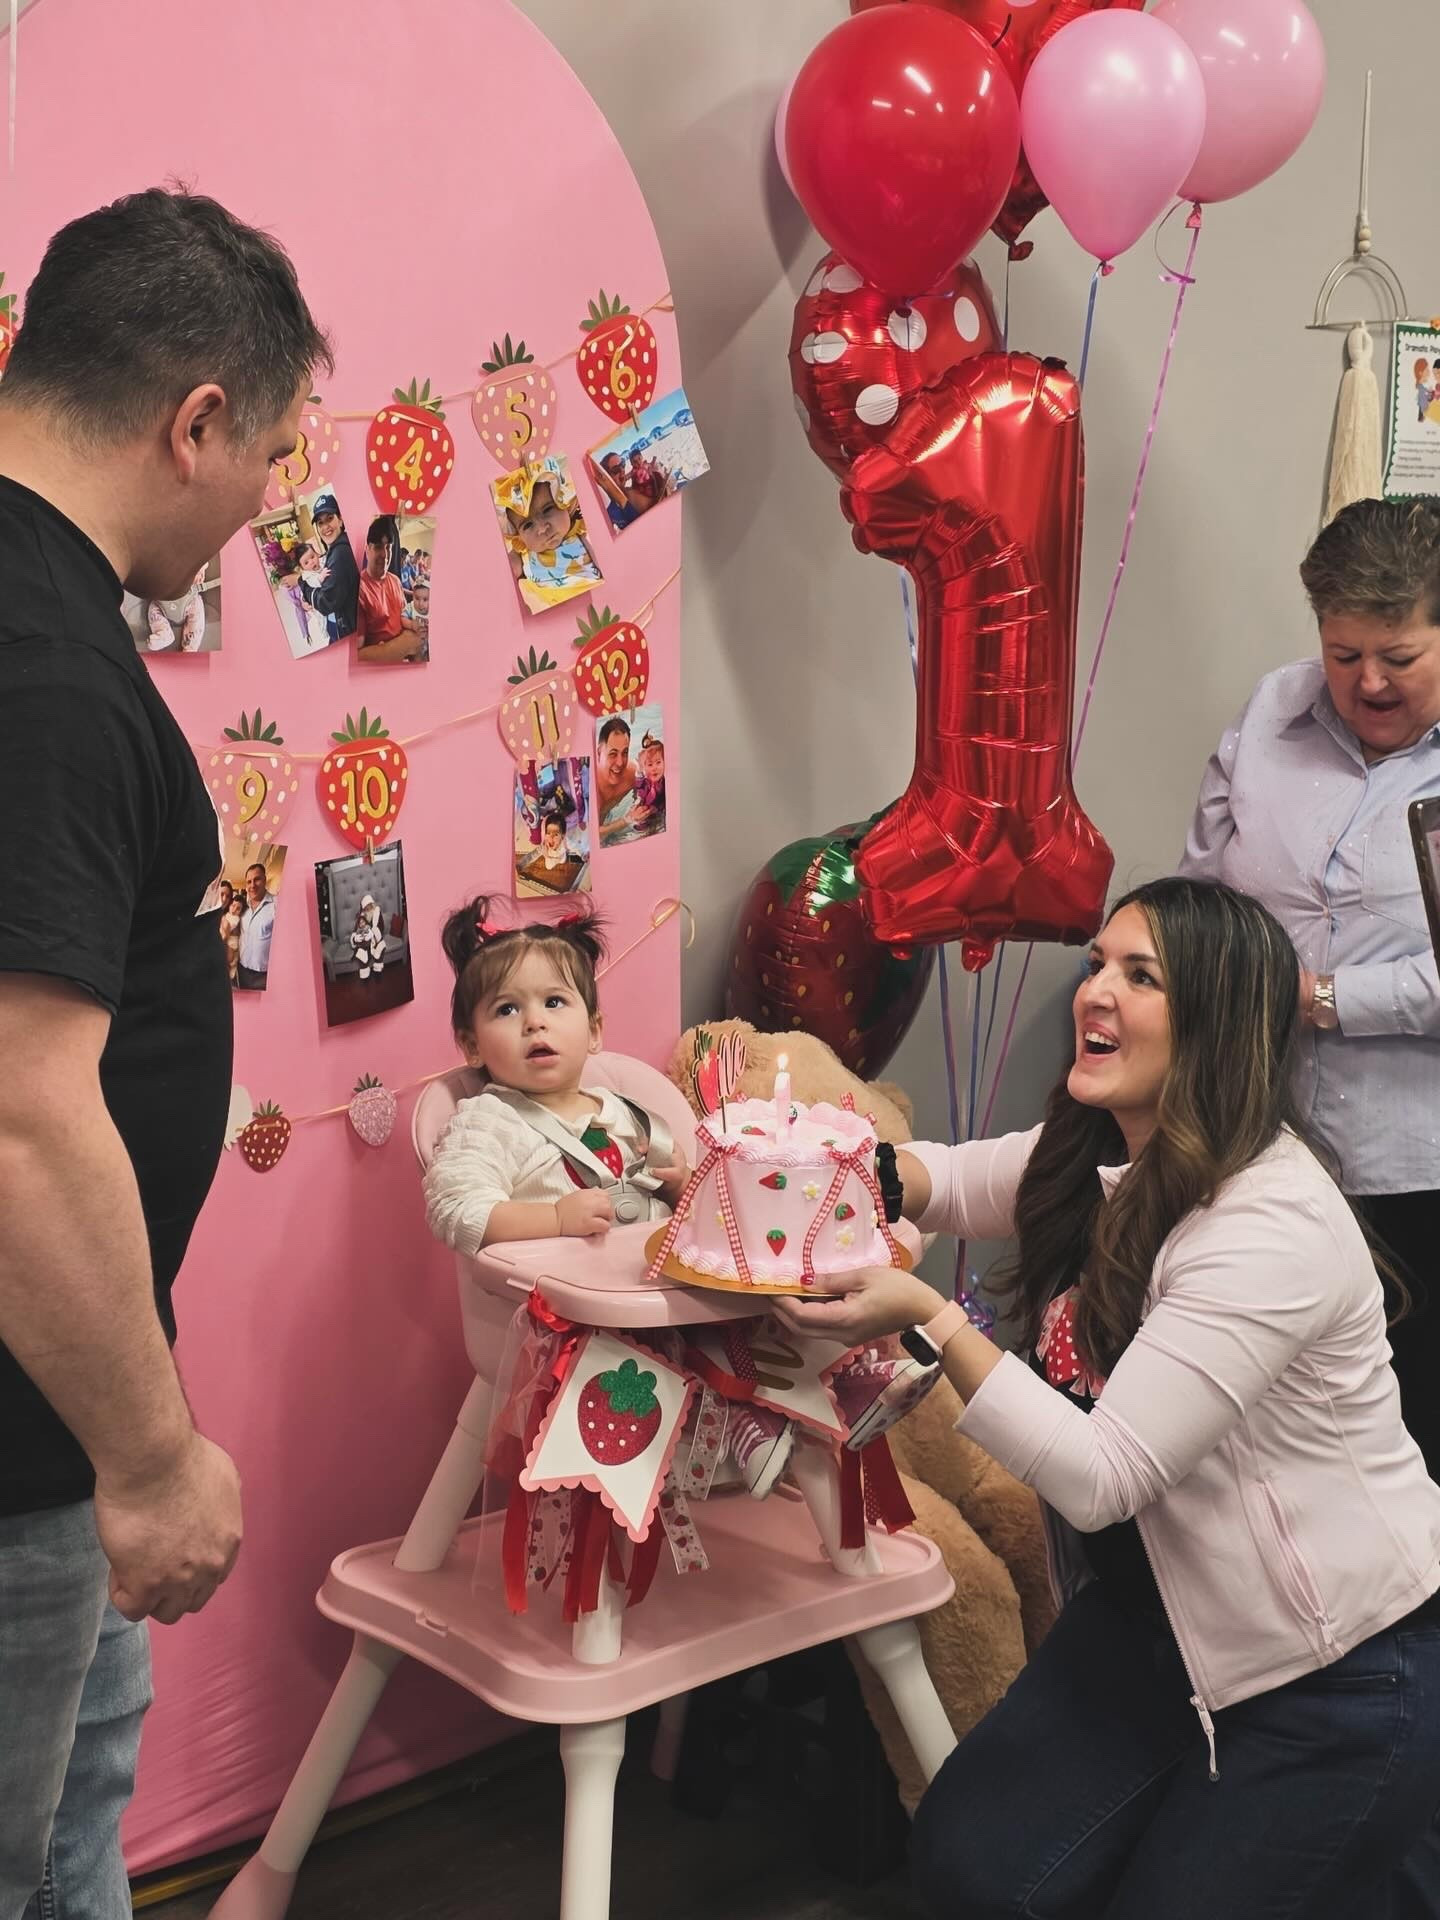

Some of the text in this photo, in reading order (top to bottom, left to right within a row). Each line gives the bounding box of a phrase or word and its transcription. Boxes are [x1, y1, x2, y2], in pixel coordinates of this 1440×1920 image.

[610, 339, 637, 399] 6
[505, 391, 532, 447] 5
[276, 431, 311, 486] 3
[394, 437, 424, 491] 4
[592, 649, 640, 709] 12
[529, 692, 560, 751] 11
[236, 769, 267, 824] 9
[341, 766, 390, 824] 10
